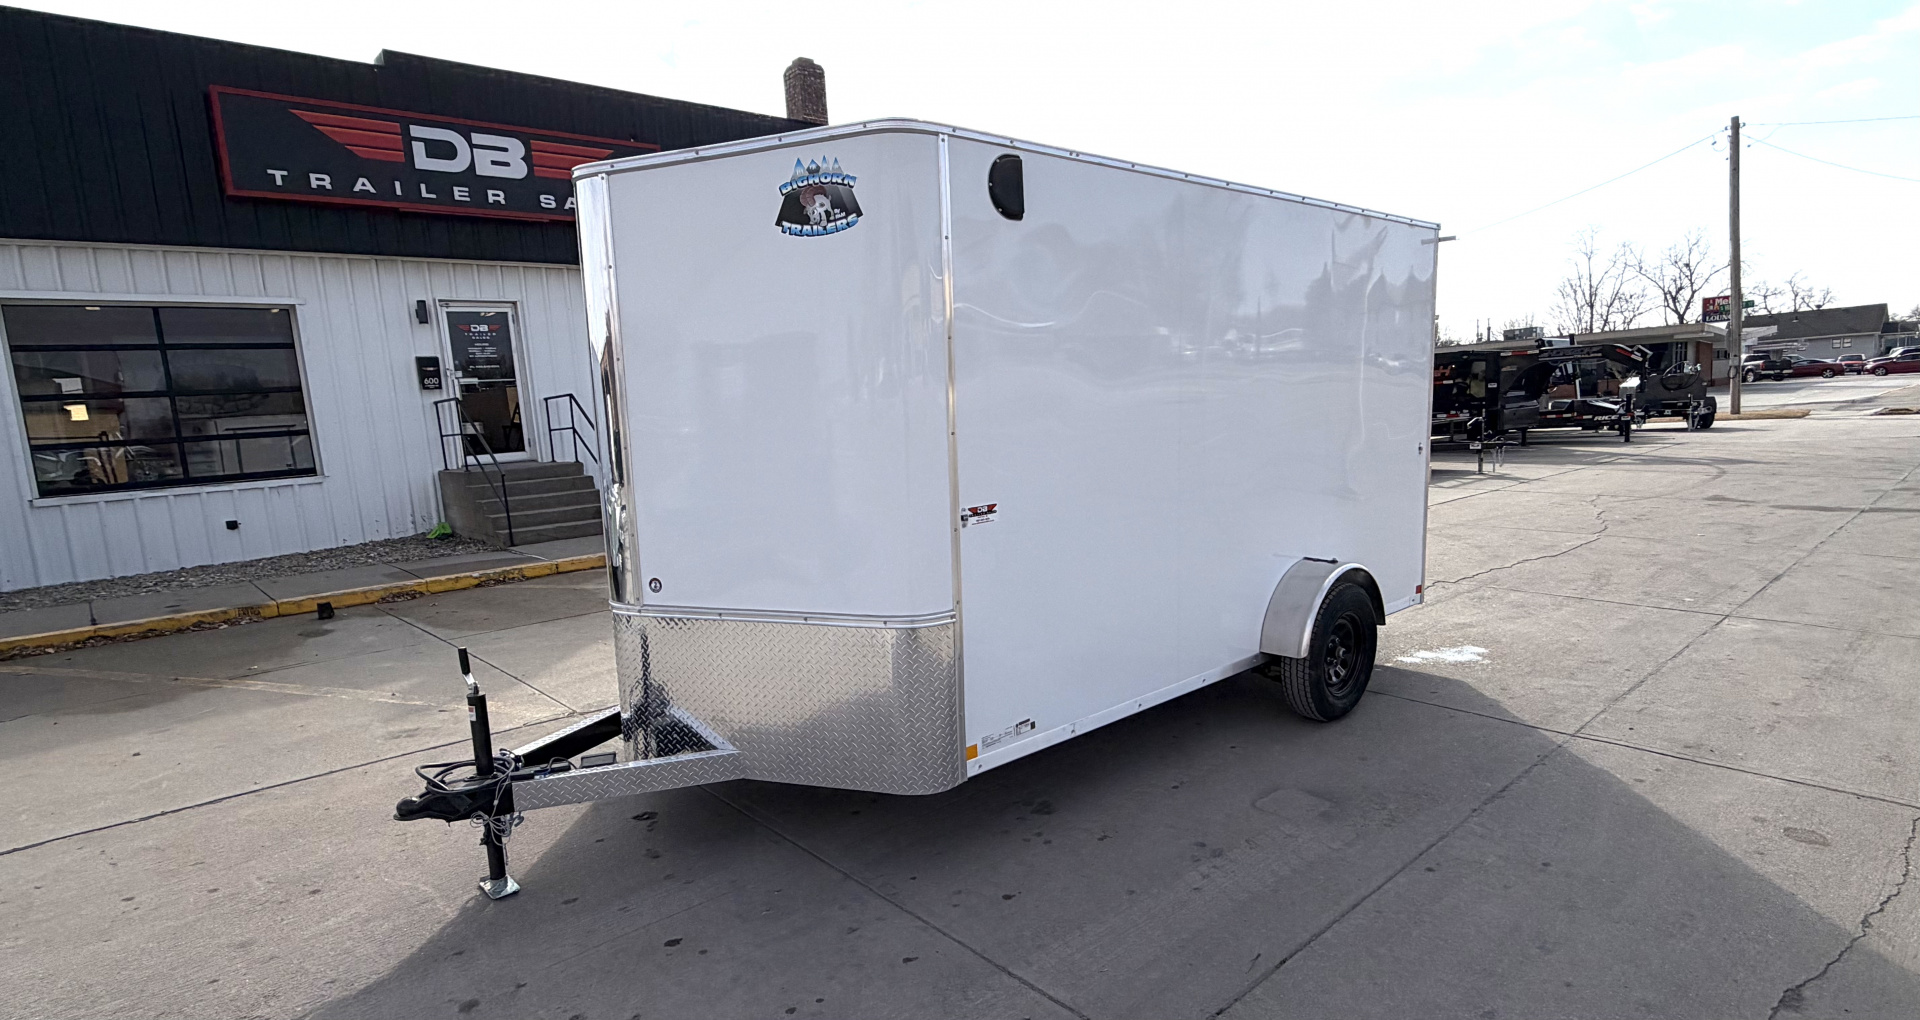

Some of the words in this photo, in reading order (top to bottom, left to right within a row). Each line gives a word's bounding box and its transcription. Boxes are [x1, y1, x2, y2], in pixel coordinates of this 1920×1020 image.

[409, 124, 528, 180] DB
[266, 169, 506, 204] TRAILER
[779, 172, 858, 197] BIGHORN
[781, 213, 859, 237] TRAILERS
